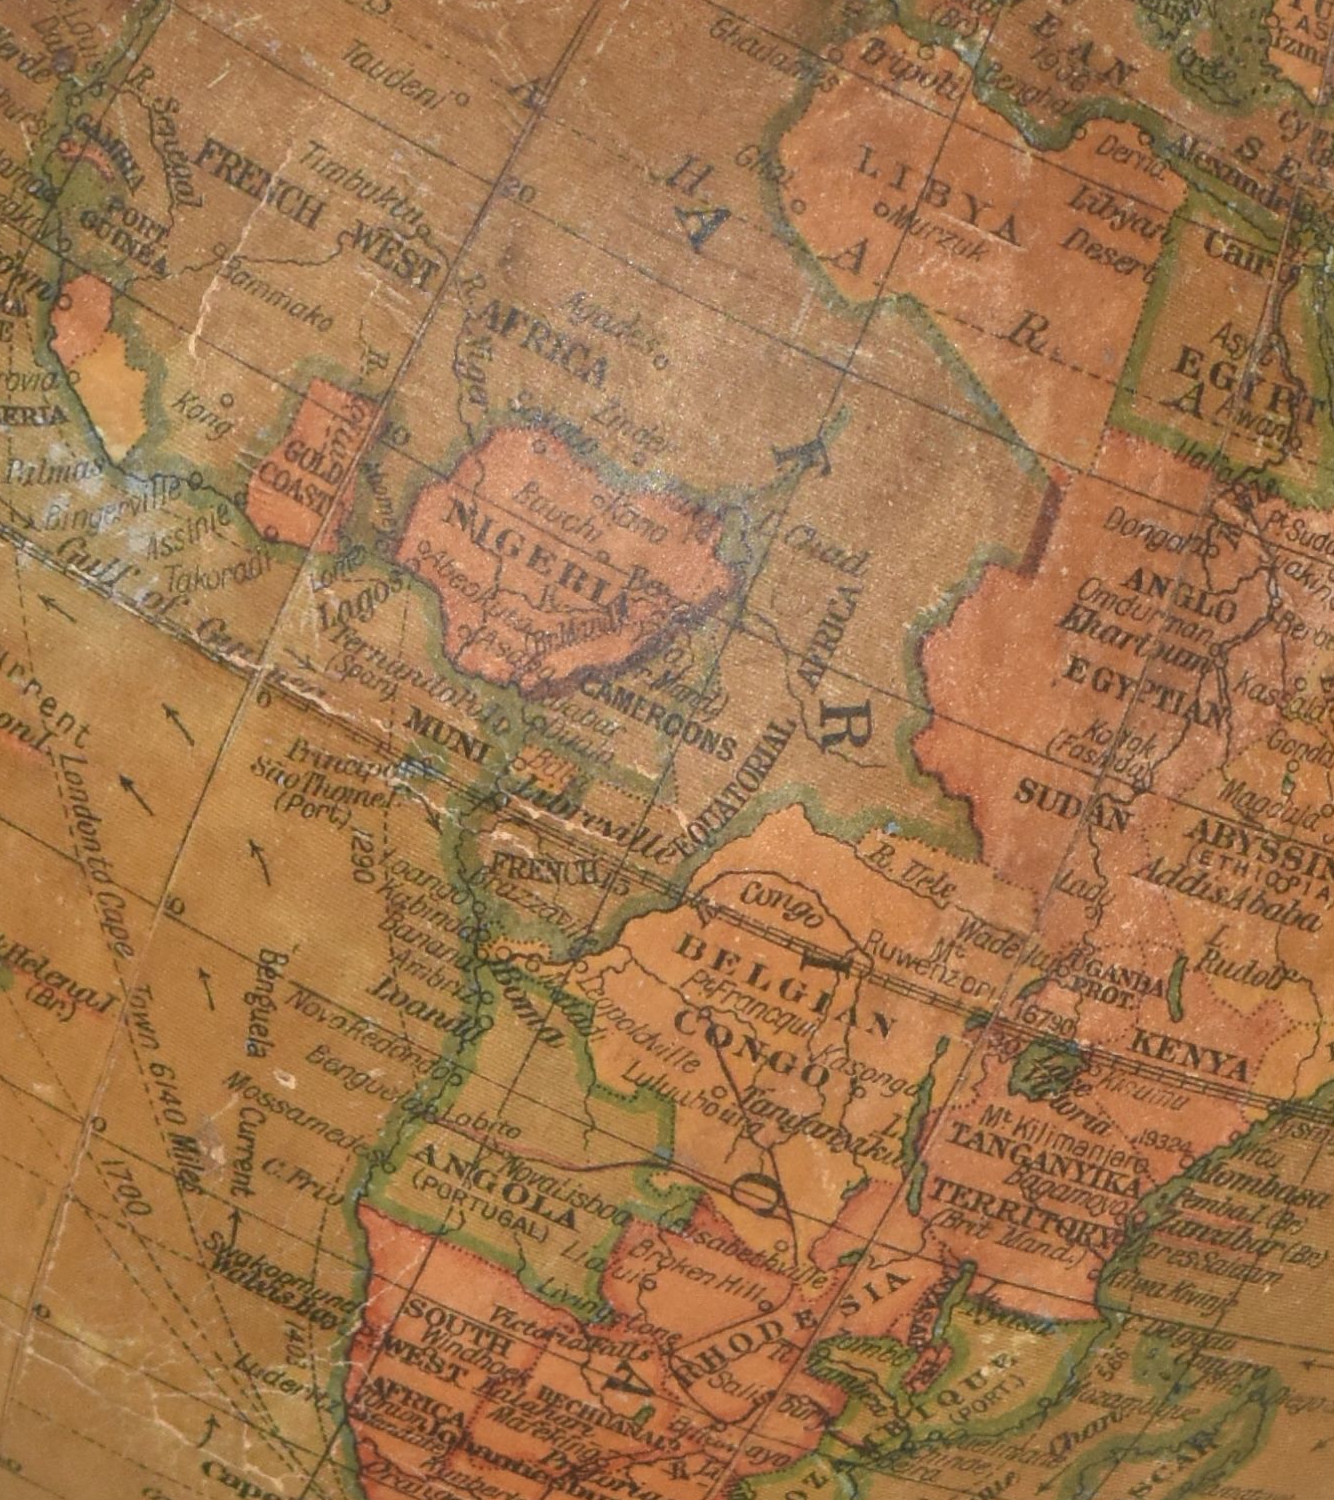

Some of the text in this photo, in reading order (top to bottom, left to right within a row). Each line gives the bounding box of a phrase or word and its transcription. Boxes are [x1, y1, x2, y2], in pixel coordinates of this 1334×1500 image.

[858, 37, 965, 102] Tripoli
[1094, 134, 1167, 182] Derna
[853, 143, 1027, 251] LIBYA
[1068, 183, 1173, 244] Libyan
[193, 136, 608, 389] FRENCH WEST AFRICA
[884, 206, 990, 263] Murzuk
[1057, 227, 1157, 284] Desert
[170, 390, 237, 444] Kong
[258, 462, 337, 520] COAST
[284, 439, 345, 487] GOLD
[441, 497, 630, 622] NIGERIA
[1121, 565, 1239, 625] ANGLO
[797, 582, 865, 693] AFRICA
[579, 680, 739, 763] CAMEROONS
[1064, 654, 1232, 733] EGYPTIAN
[403, 704, 497, 764] MUNI
[673, 715, 797, 859] EQUATORIAL
[1014, 777, 1135, 834] SUDAN
[490, 851, 600, 892] FRENCH
[1130, 857, 1324, 934] Addis Ababa
[489, 960, 568, 1049] Boma
[672, 931, 898, 1038] BELGIAN
[95, 888, 136, 959] Cape
[127, 983, 161, 1052] Town
[148, 1061, 188, 1127] 6140
[170, 1133, 205, 1196] Miles
[230, 946, 290, 1199] Benguela Current
[673, 1008, 831, 1088] CONGO
[1128, 1026, 1252, 1084] KENYA
[441, 1105, 523, 1140] Lobito
[406, 1142, 581, 1232] ANGOLA
[947, 1120, 1145, 1201] TANGANYIKA
[411, 1165, 550, 1244] (PORTUGAL)
[929, 1175, 1126, 1249] TERRITORY
[381, 1331, 472, 1389] WEST
[401, 1299, 517, 1357] SOUTH
[674, 1267, 912, 1389] RHODESIA
[366, 1374, 467, 1429] AFRICA
